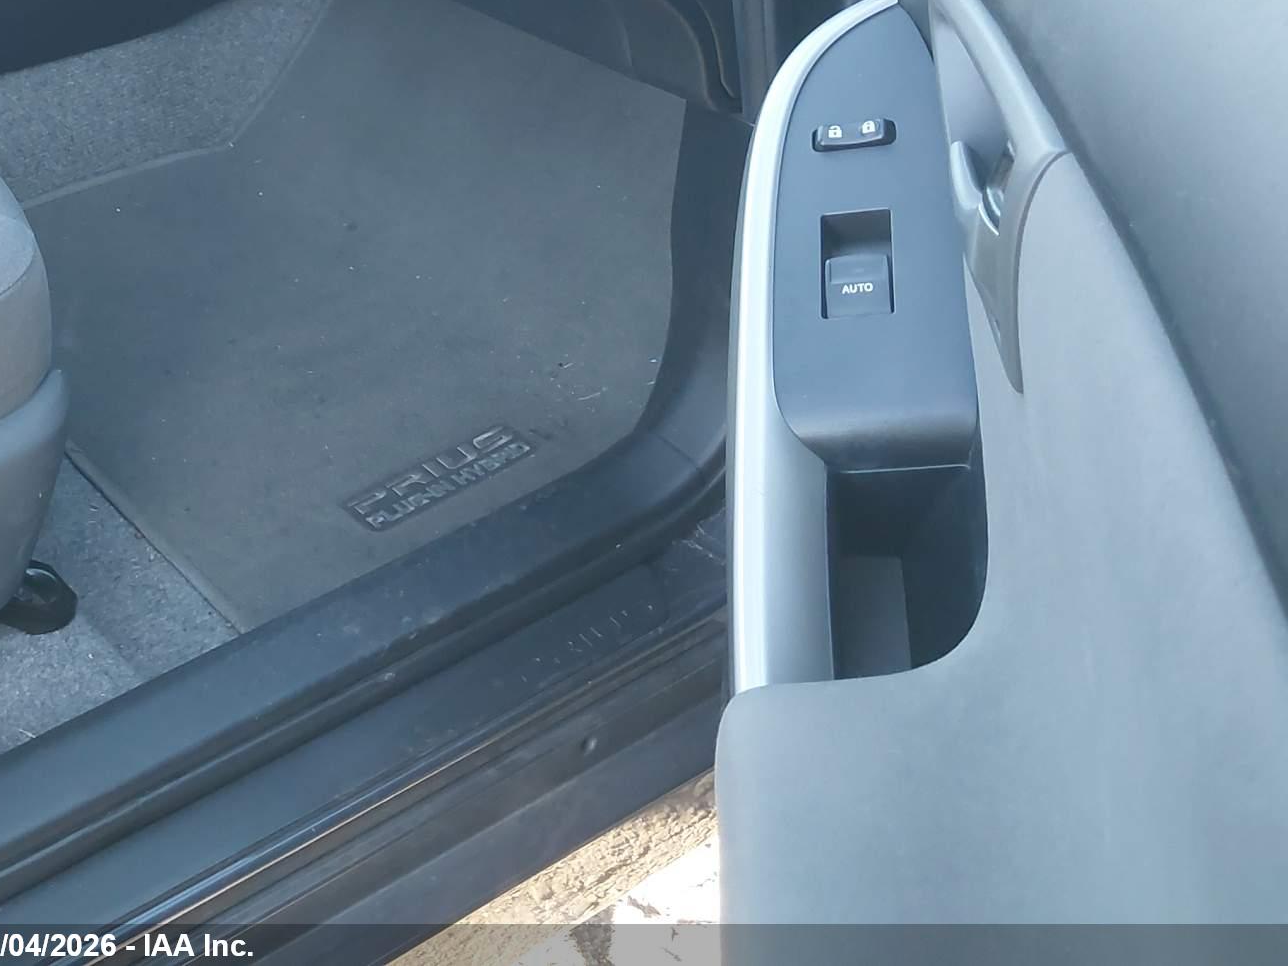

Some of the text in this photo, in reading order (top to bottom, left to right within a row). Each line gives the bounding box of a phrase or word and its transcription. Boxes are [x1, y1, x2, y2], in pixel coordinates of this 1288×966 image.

[841, 282, 874, 294] AUTO
[346, 425, 514, 515] PRIUS
[450, 440, 532, 486] HYBRID
